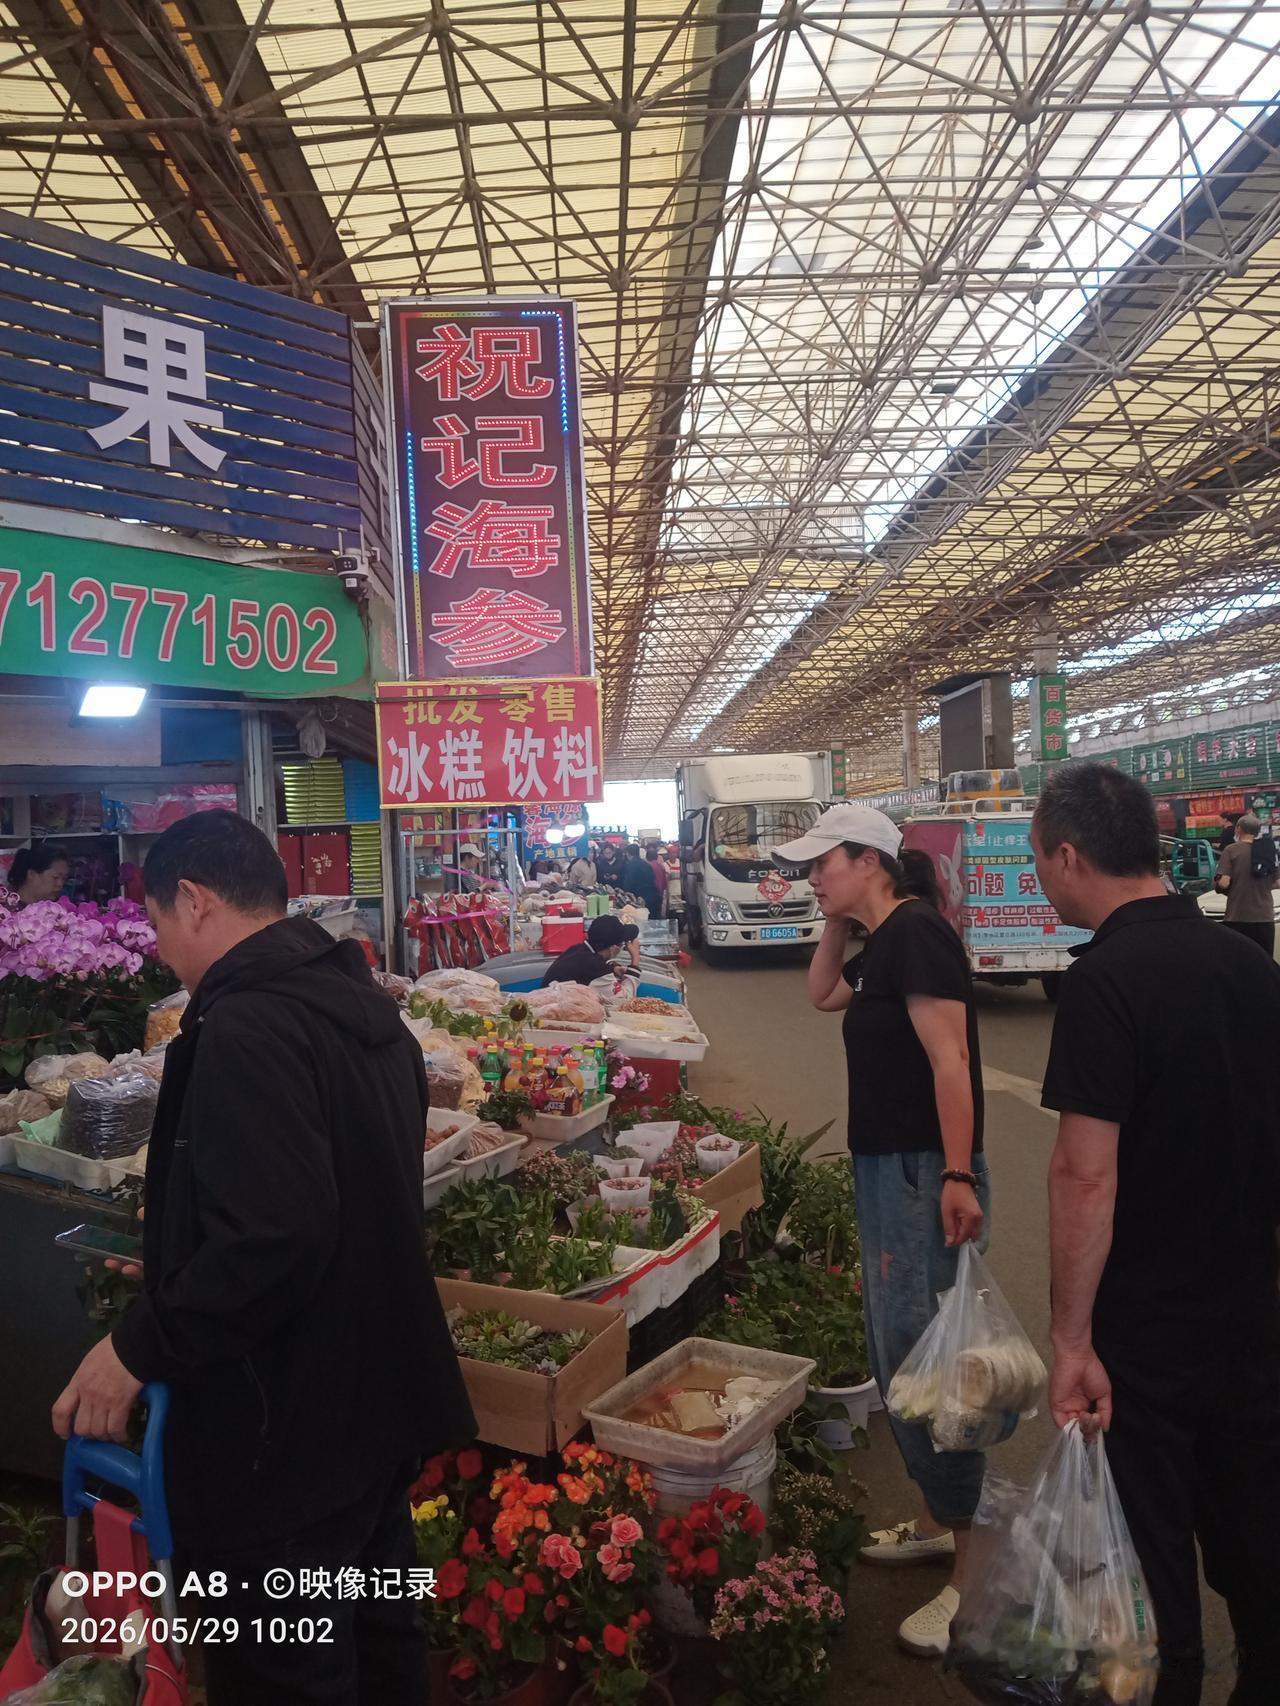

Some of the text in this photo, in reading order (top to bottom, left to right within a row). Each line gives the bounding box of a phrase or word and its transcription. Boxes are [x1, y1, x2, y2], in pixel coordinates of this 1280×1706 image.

[86, 304, 227, 473] 果
[416, 323, 568, 670] 祝记海参
[402, 684, 576, 725] 批发 零售
[1043, 686, 1064, 752] 百货市
[387, 726, 599, 802] 冰糕 饮料
[964, 855, 1028, 864] 类顽固型皮肤问题
[1018, 871, 1047, 896] 免
